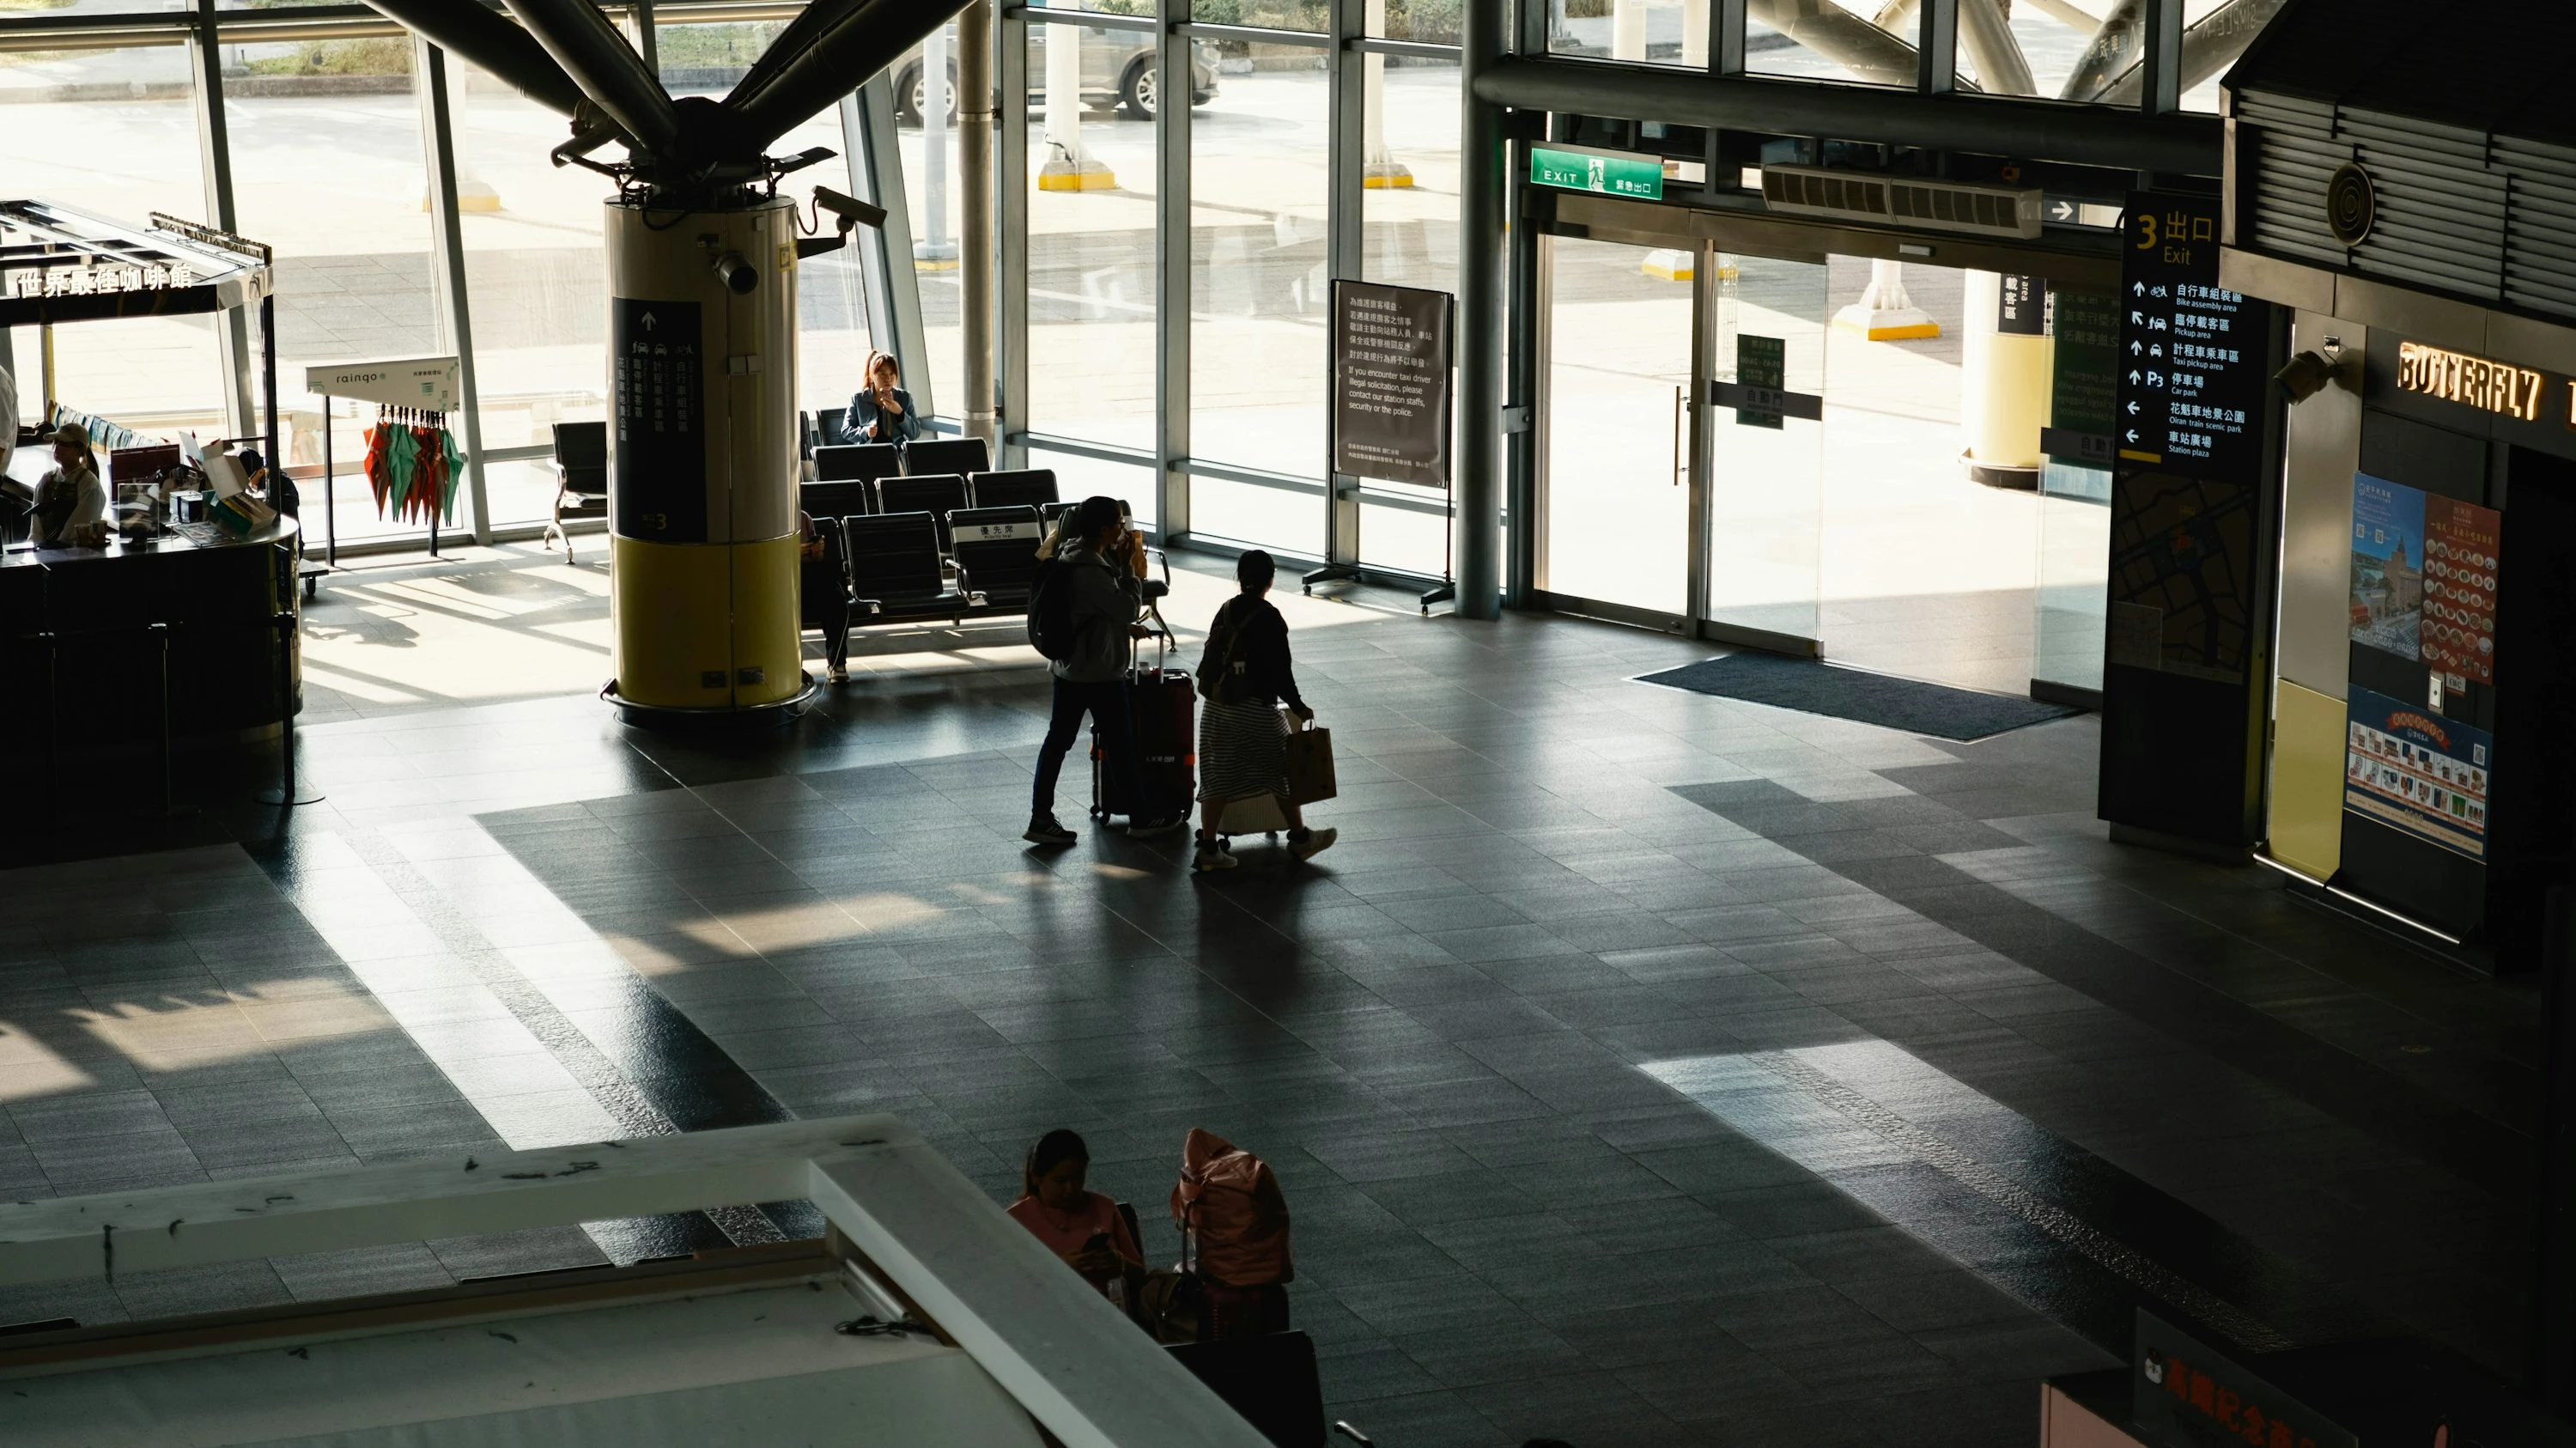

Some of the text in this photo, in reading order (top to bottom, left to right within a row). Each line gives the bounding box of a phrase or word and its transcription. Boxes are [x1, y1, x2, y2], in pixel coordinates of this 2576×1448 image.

[1544, 170, 1577, 183] EXIT
[1616, 179, 1651, 193] 緊急出口
[2137, 214, 2156, 249] 3
[2166, 210, 2213, 242] 出口
[2164, 246, 2191, 265] Exit
[18, 263, 193, 300] 世界最佳咖啡館
[2004, 273, 2018, 320] 載客區
[2177, 283, 2243, 303] 自行車組裝區
[2176, 297, 2238, 313] Bike assembly area
[2174, 313, 2230, 332] 臨停載客區
[2174, 327, 2196, 338] Pickup
[2173, 342, 2239, 363] 計程車乘車區
[2173, 356, 2186, 366] Taxi
[2187, 358, 2208, 369] pickup
[336, 372, 378, 384] raingo
[1355, 368, 1367, 376] you
[1367, 369, 1398, 379] encounter
[1400, 373, 1412, 381] taxi
[1413, 374, 1432, 384] driver
[2147, 370, 2164, 387] P3
[2172, 372, 2204, 389] 停車場
[2397, 341, 2543, 422] BUTTERFLY
[1349, 378, 1423, 395] illegal solicitation, please
[2172, 386, 2197, 398] Car park
[1349, 390, 1371, 400] contact
[1383, 394, 1406, 405] station
[1406, 398, 1425, 408] staffs,
[1349, 402, 1372, 412] security
[1382, 405, 1392, 415] the
[1393, 408, 1413, 417] police.
[2170, 401, 2245, 423] 花魁車地景公園
[2169, 416, 2242, 433] Oiran train scenic park
[2168, 430, 2212, 449] 車站廣場
[2168, 444, 2209, 458] Station plaza
[656, 513, 667, 530] 3
[2165, 1355, 2317, 1448] 高鐵紀念商
